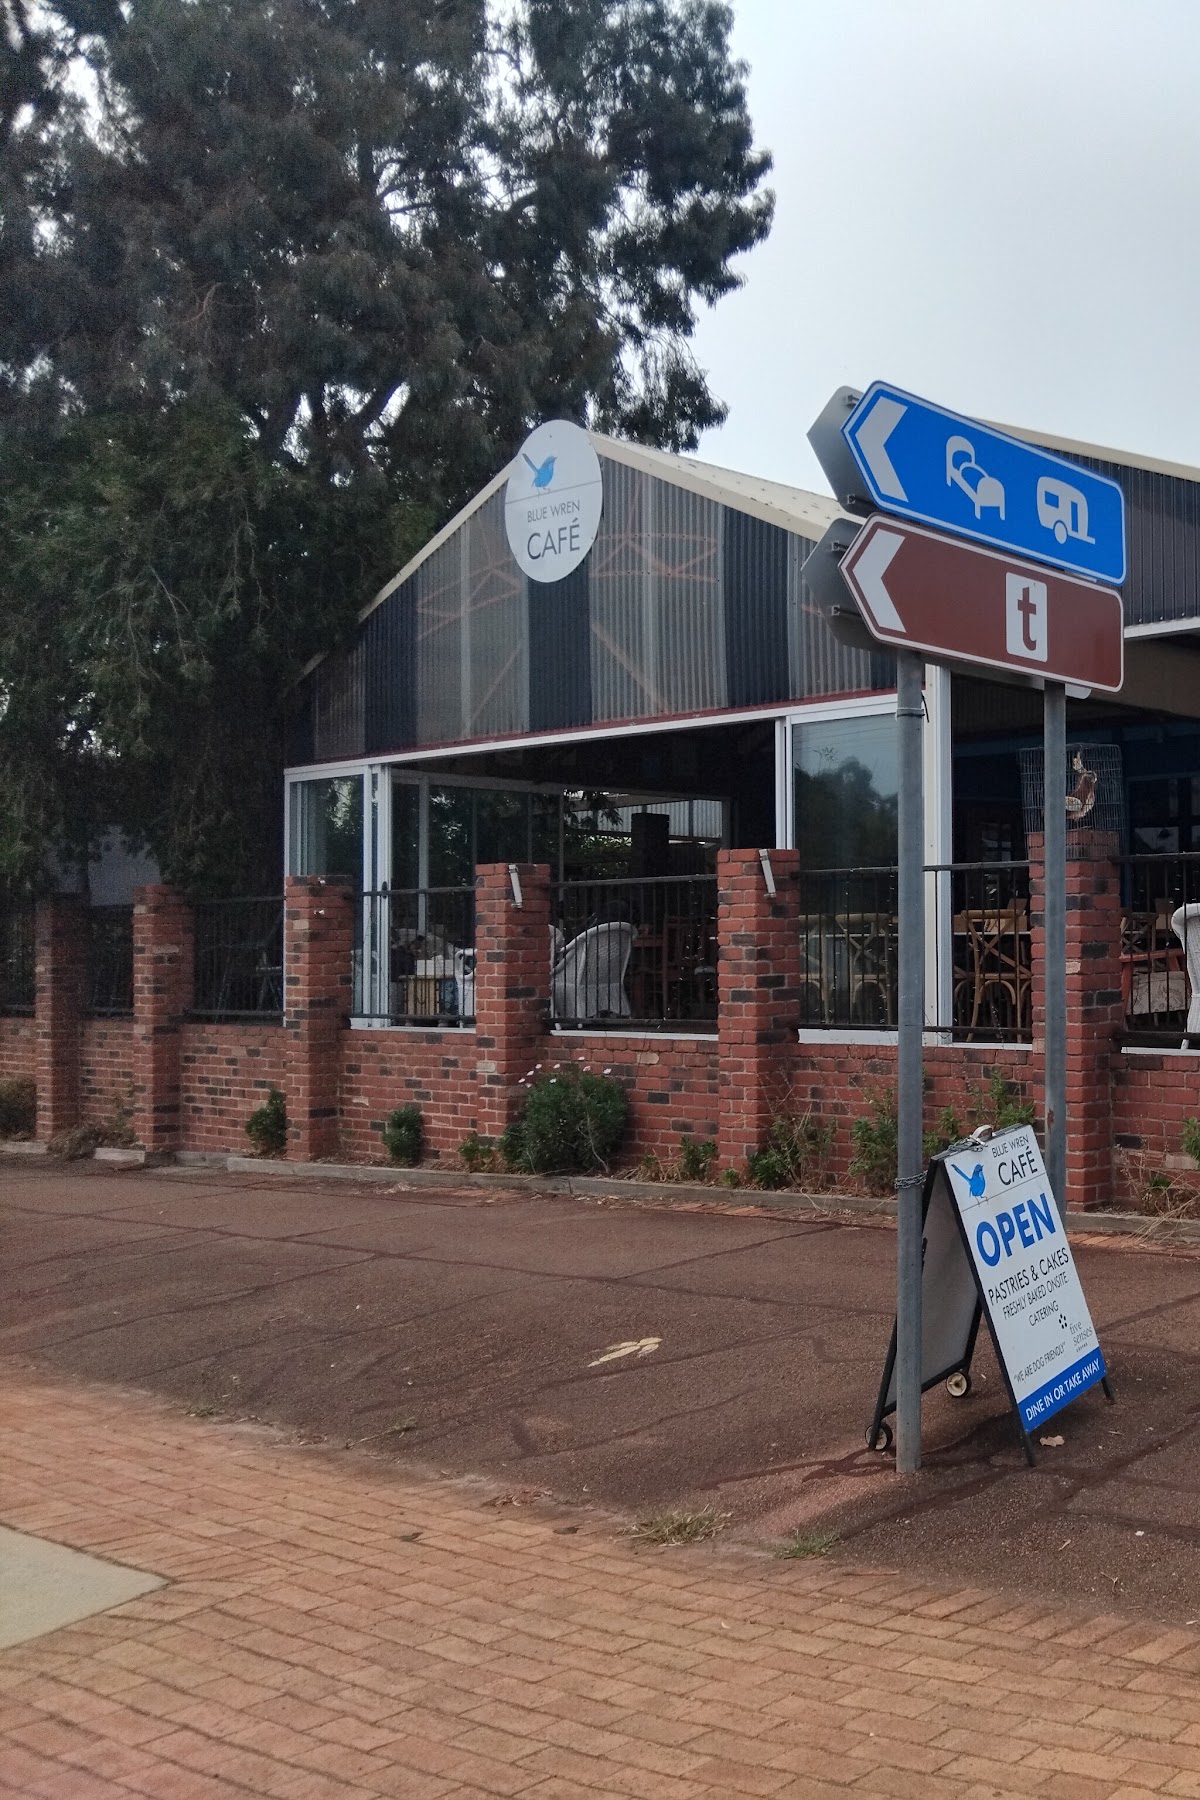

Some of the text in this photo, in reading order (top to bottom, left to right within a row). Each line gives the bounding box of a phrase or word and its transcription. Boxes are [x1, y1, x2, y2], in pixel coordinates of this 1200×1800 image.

[527, 500, 581, 523] BLUE WREN
[527, 517, 581, 560] CAFÉ
[991, 1134, 1029, 1158] BLUE WREN
[998, 1146, 1038, 1185] CAFÉ
[976, 1193, 1056, 1267] OPEN
[988, 1247, 1069, 1306] PASTRIES & CAKES
[1002, 1294, 1027, 1320] FRESHLY
[1027, 1284, 1047, 1305] BAKED
[1028, 1300, 1059, 1326] CATERING
[1069, 1321, 1082, 1335] five
[1073, 1327, 1093, 1347] senses
[1024, 1363, 1034, 1377] ARE
[1032, 1357, 1045, 1372] DOG
[1025, 1357, 1100, 1421] DINE IN OR TAKE AWAY
